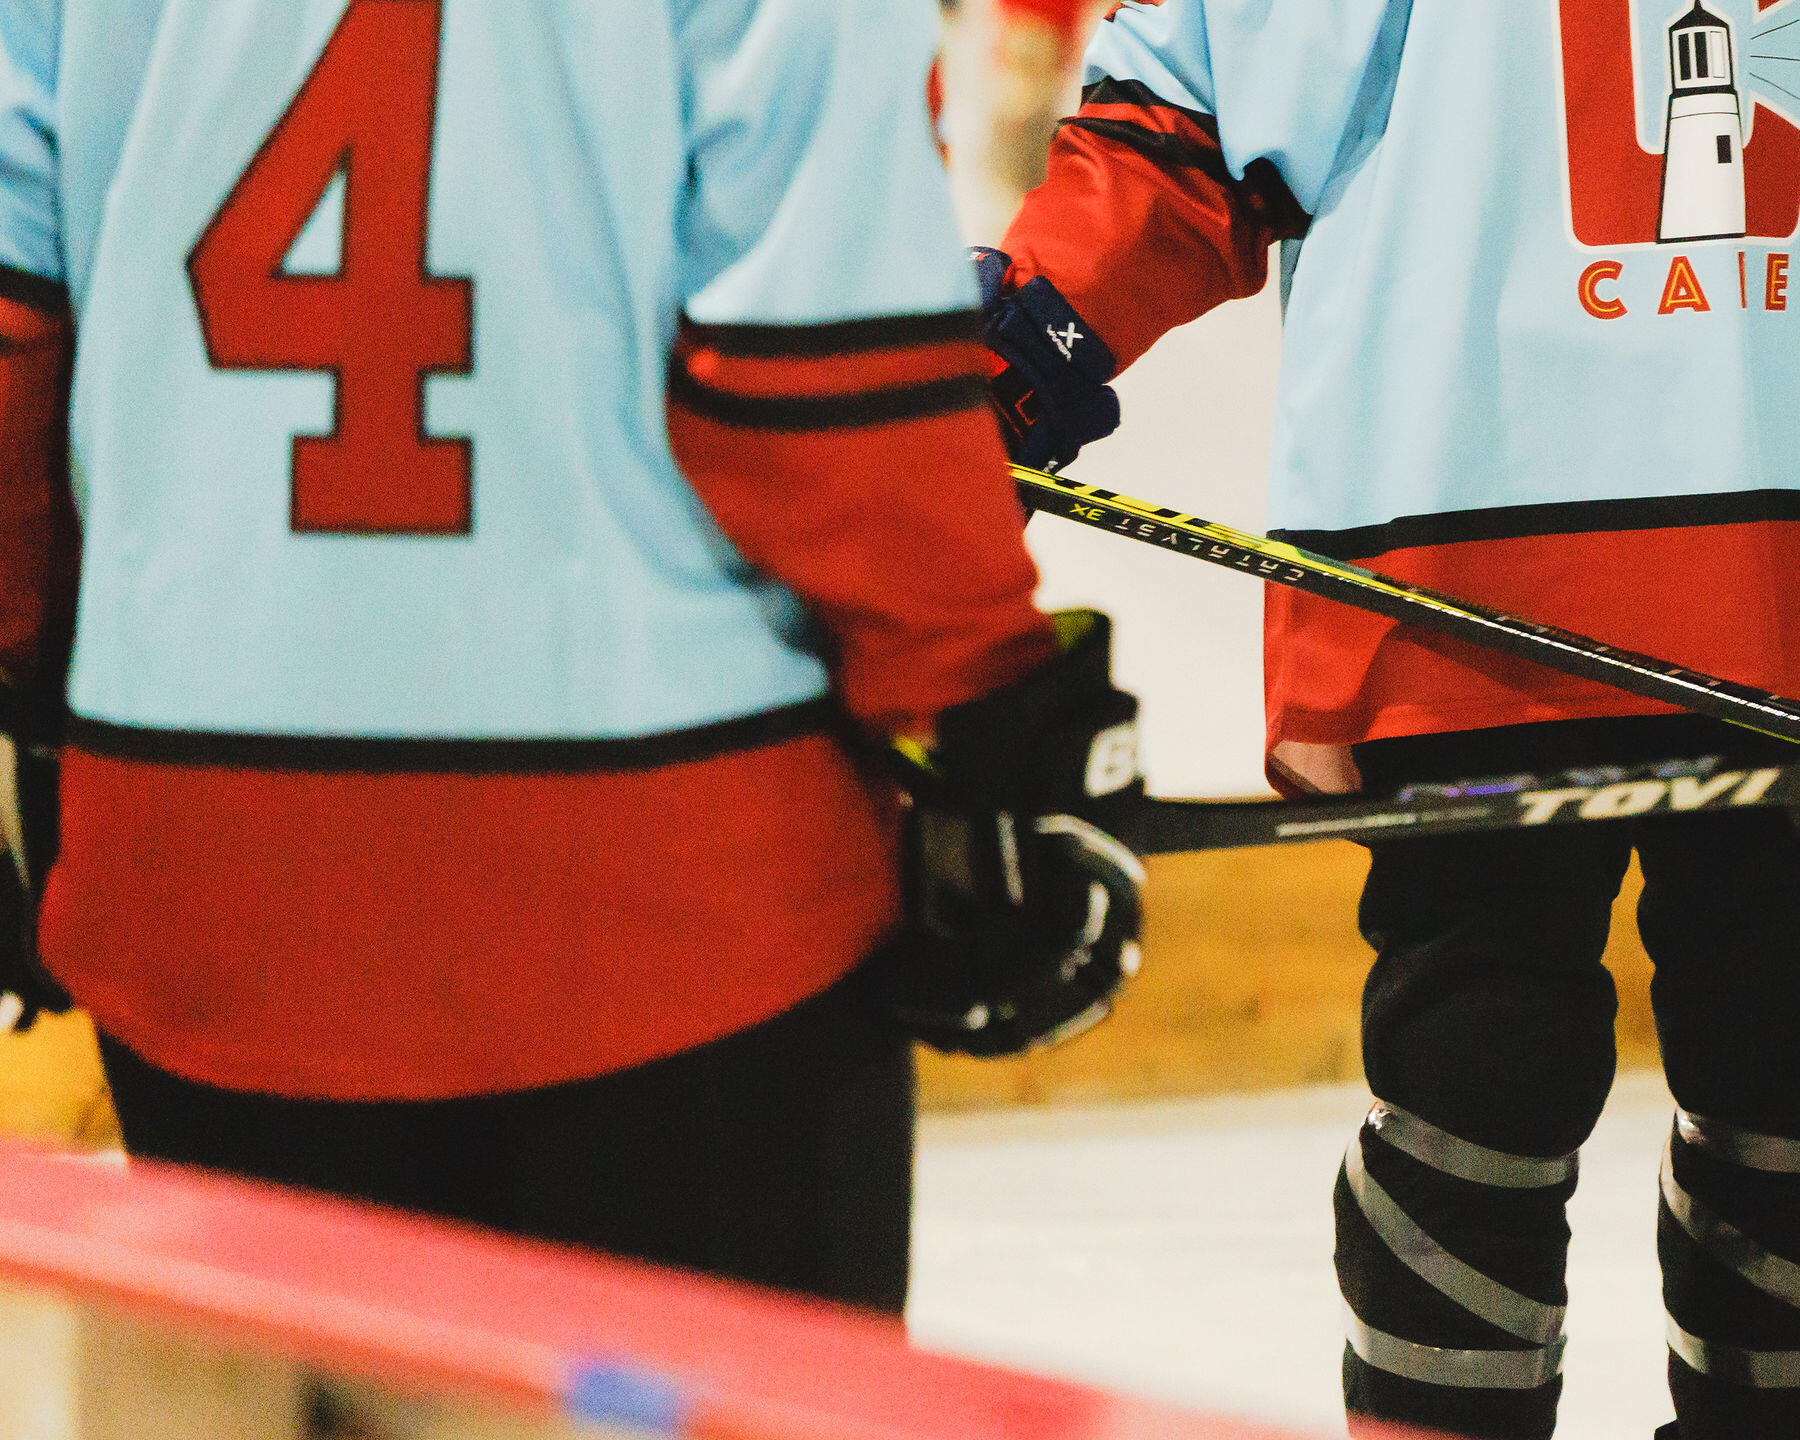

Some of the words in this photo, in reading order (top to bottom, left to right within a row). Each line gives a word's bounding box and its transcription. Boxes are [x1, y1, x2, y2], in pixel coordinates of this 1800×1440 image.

[1577, 251, 1790, 321] CAE
[1068, 503, 1106, 521] 3X
[1113, 517, 1305, 582] CATALYST
[1519, 766, 1781, 827] TOVI
